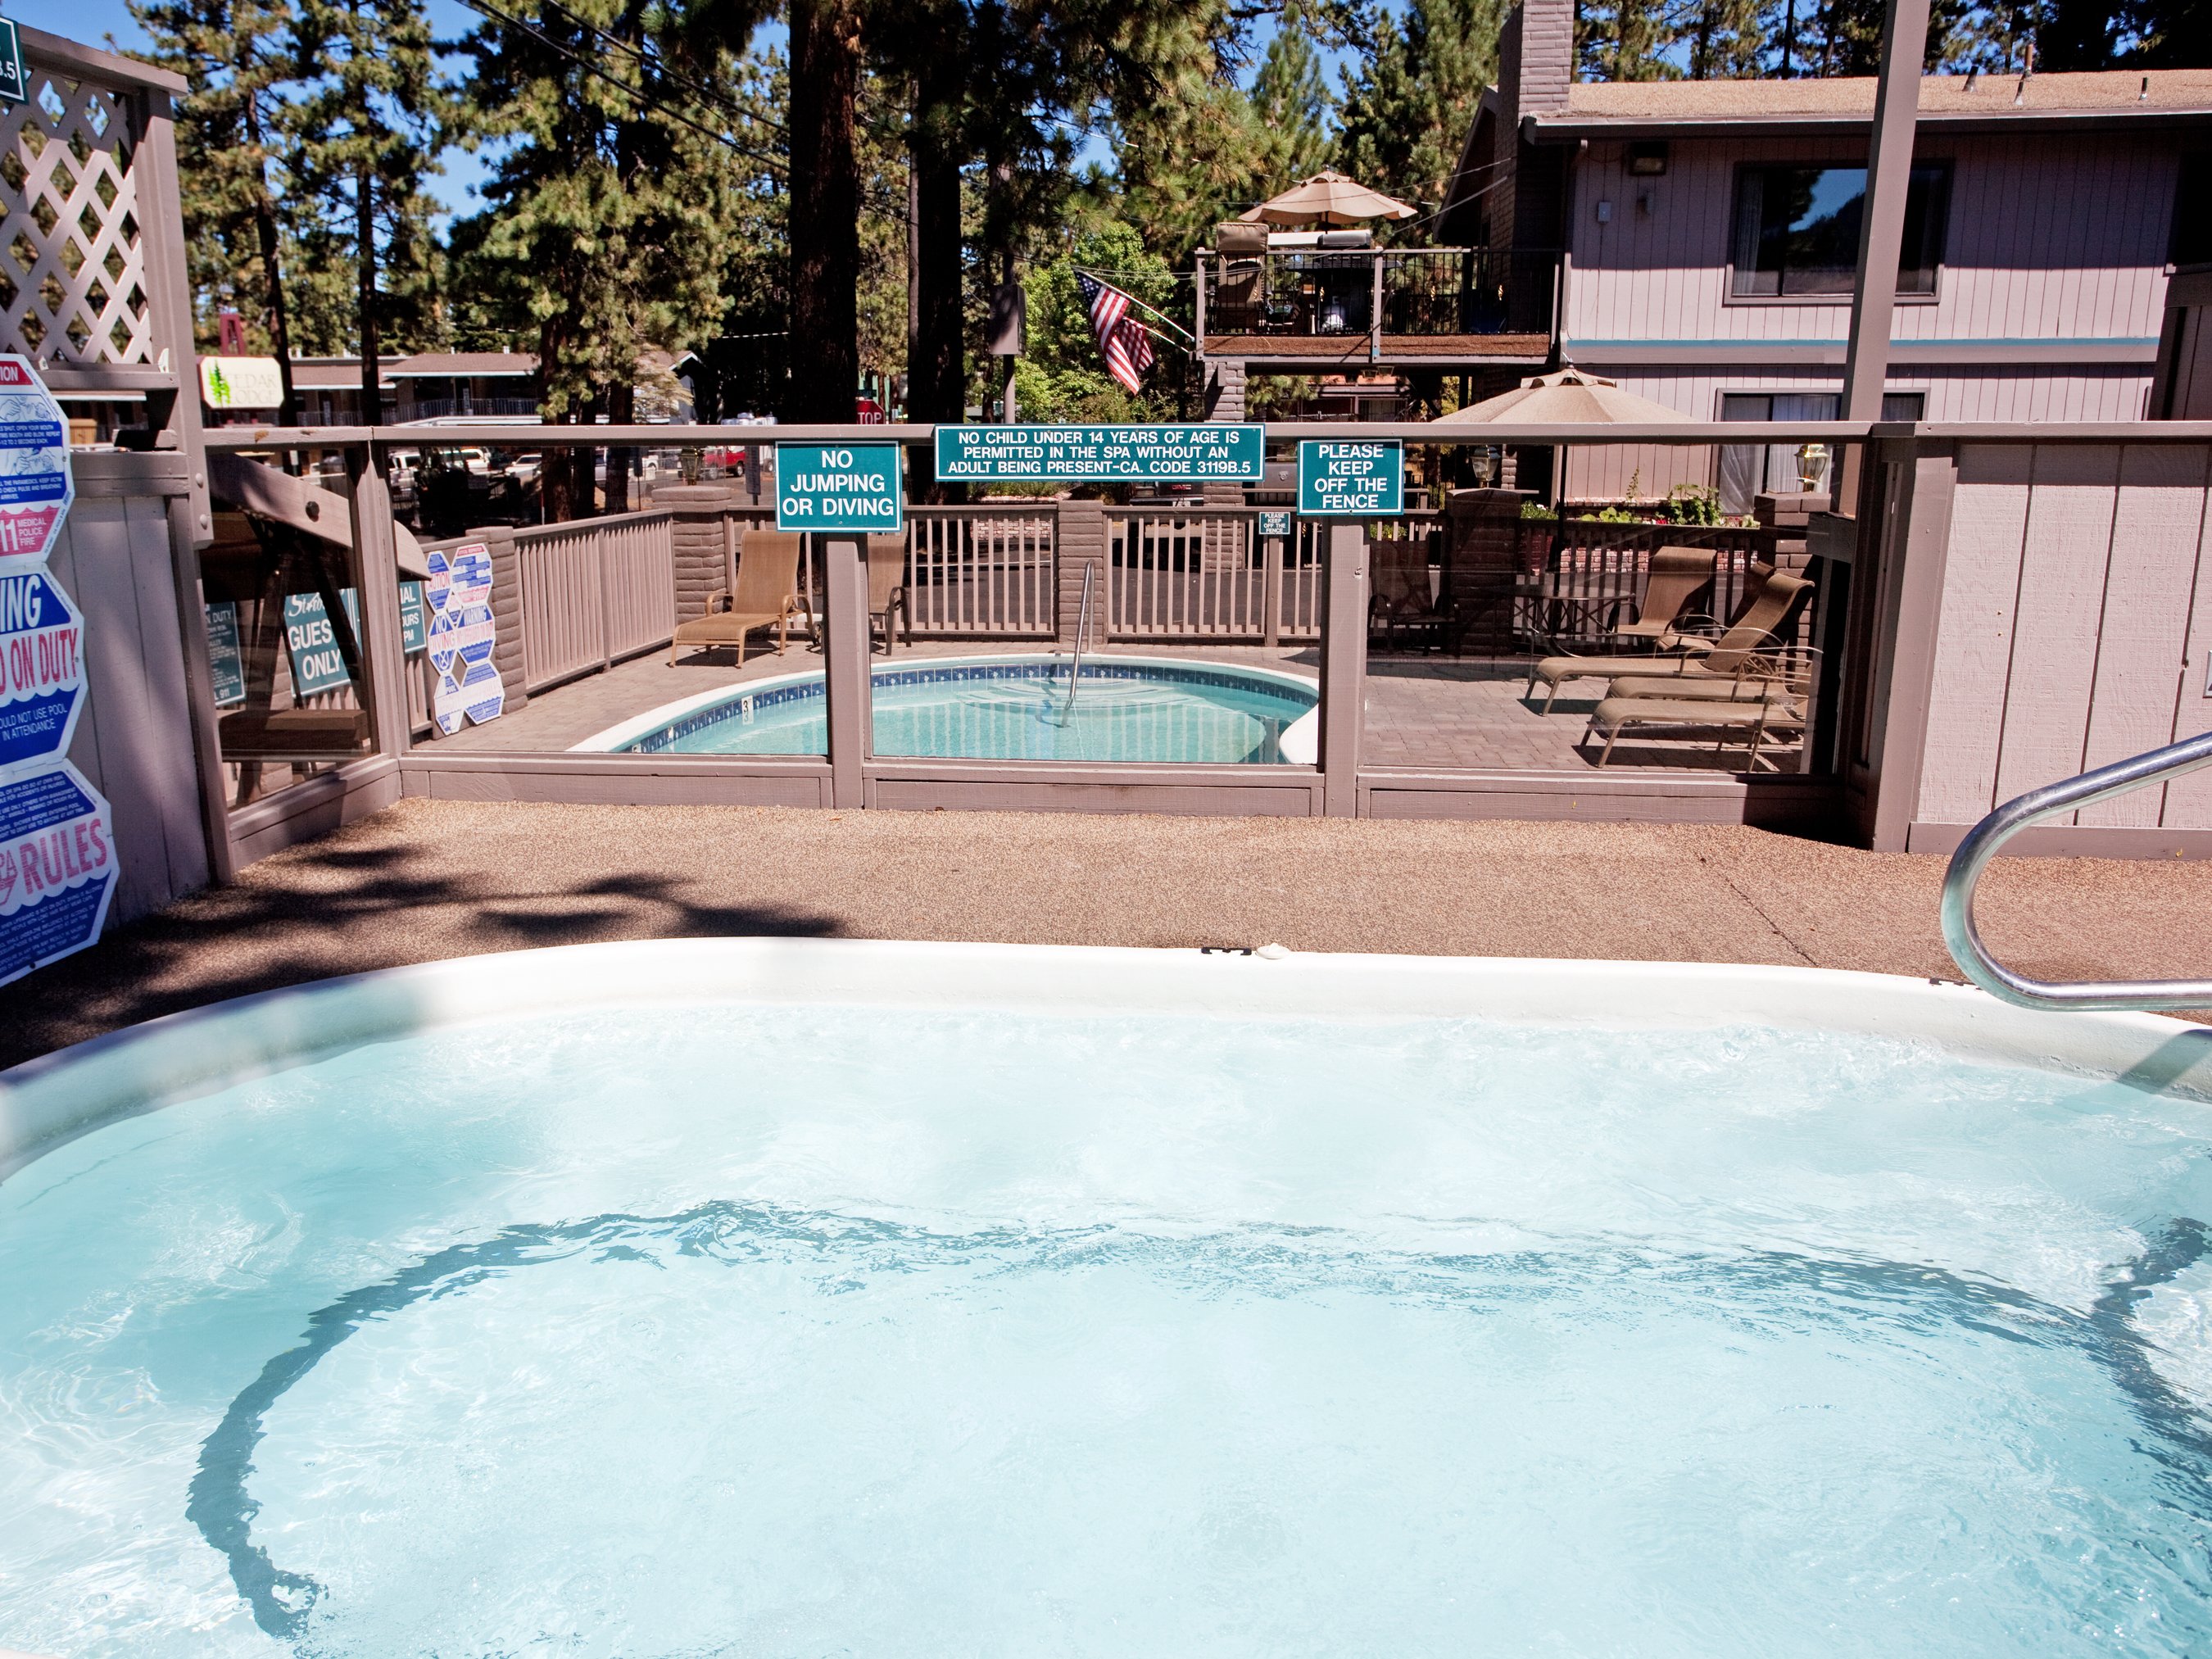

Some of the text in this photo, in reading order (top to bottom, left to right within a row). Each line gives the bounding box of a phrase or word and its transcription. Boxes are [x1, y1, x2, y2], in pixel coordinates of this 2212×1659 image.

[857, 411, 882, 424] TOP
[959, 431, 1239, 444] NO CHILD UNDER 14 YEARS OF AGE IS
[964, 446, 1227, 459] PERMITTED IN THE SPA WITHOUT AN
[1318, 444, 1384, 459] PLEASE
[822, 451, 852, 469] NO
[949, 460, 1250, 474] ADULT BEING PRESENT-CA. CODE 3119B.5
[1328, 460, 1374, 475] KEEP
[790, 474, 884, 492] JUMPING
[1314, 477, 1388, 492] OFF THE
[782, 497, 894, 516] OR DIVING
[1322, 493, 1379, 509] FENCE
[17, 517, 47, 528] MEDICAL
[19, 528, 43, 537] POLICE
[20, 537, 36, 546] FIRE
[213, 610, 233, 623] DUTY
[463, 604, 487, 628] WARNING
[435, 615, 447, 634] NO
[288, 619, 333, 652] GUES
[403, 628, 415, 642] PM
[11, 636, 36, 691] ON
[39, 628, 78, 685] DUTY
[302, 648, 341, 681] ONLY
[219, 687, 230, 699] 911
[17, 710, 32, 724] NOT
[33, 707, 48, 719] USE
[48, 703, 68, 717] POOL
[2, 718, 57, 741] IN ATTENDANCE
[19, 818, 107, 895] RULES
